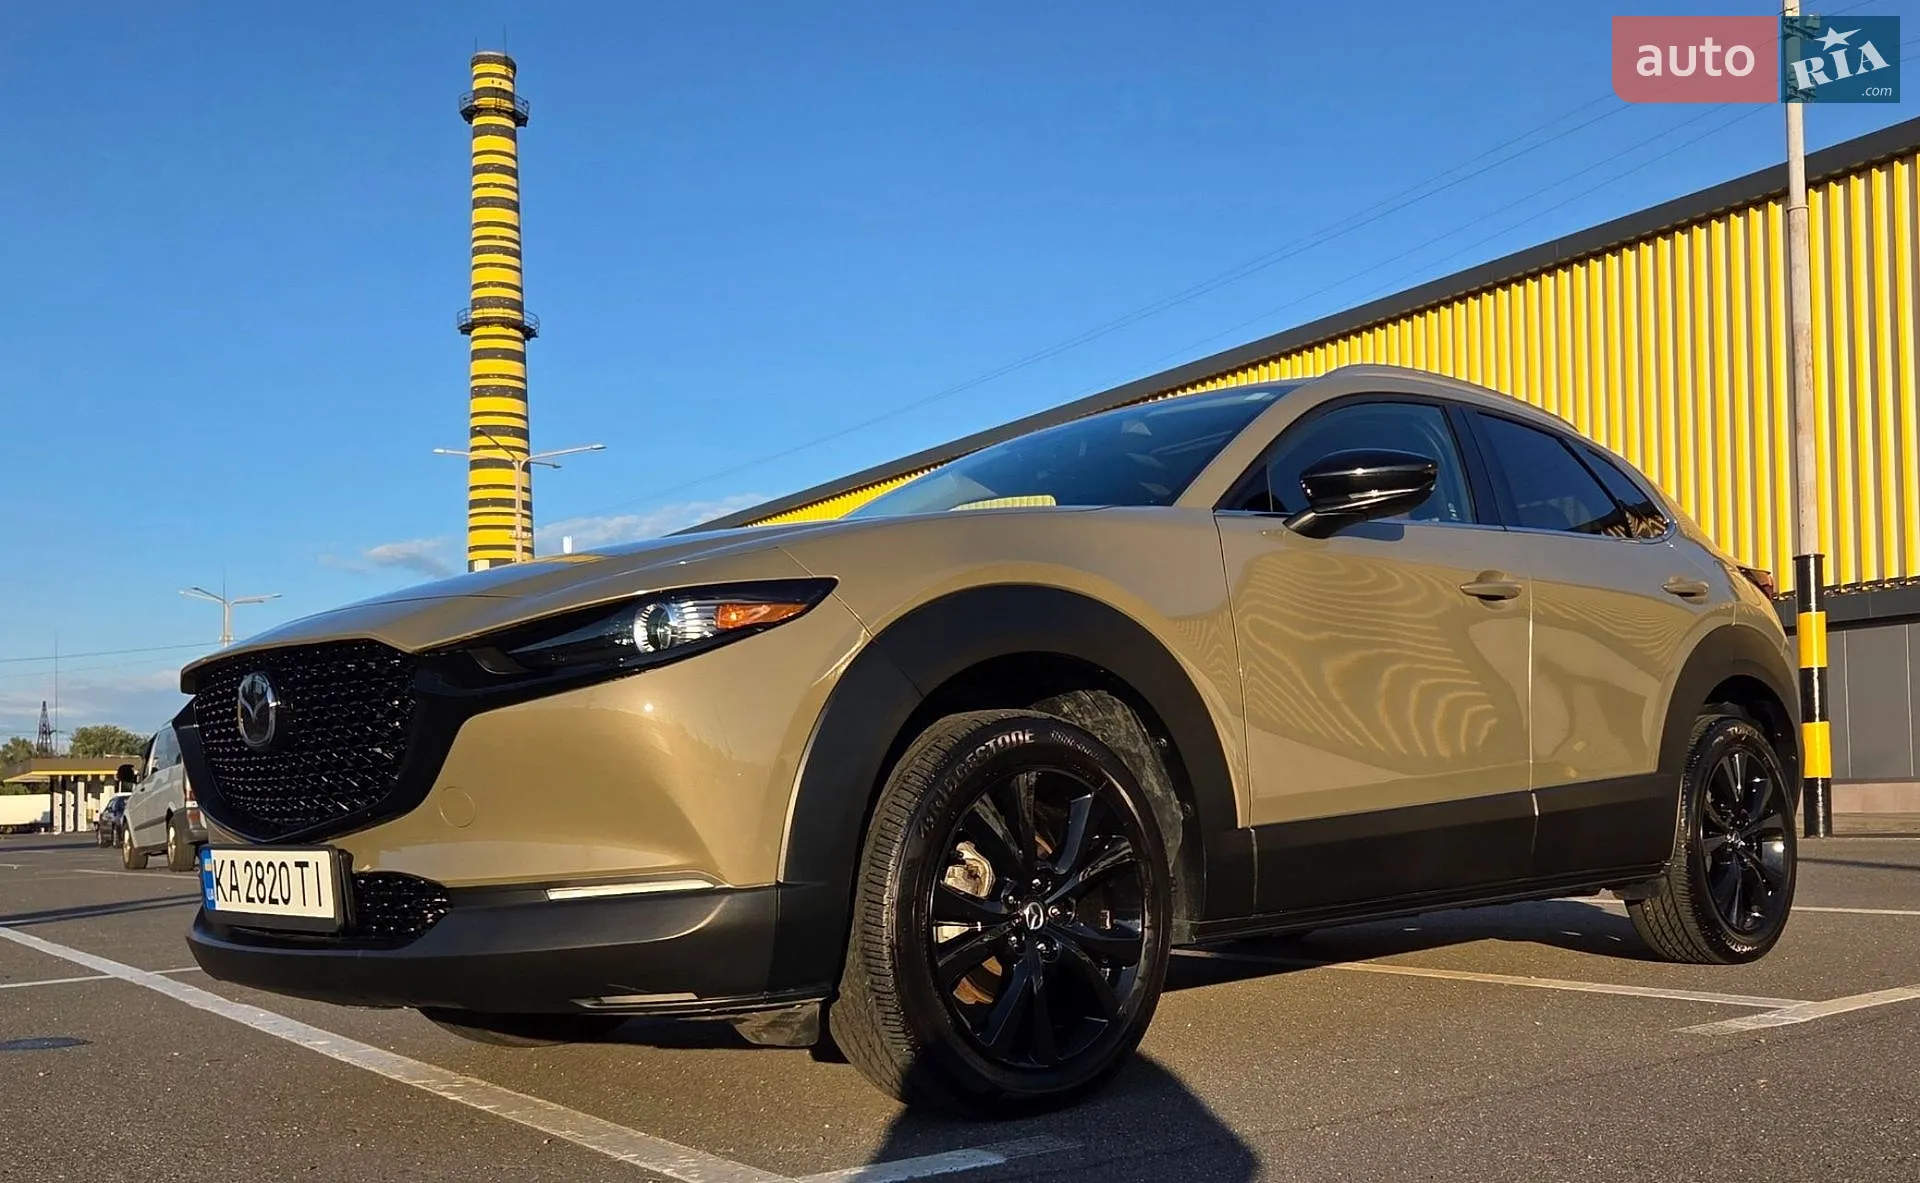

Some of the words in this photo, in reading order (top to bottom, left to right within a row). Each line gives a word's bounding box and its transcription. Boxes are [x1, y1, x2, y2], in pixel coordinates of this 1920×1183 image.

[213, 859, 241, 903] KA
[244, 861, 291, 905] 2820
[294, 861, 322, 907] TI
